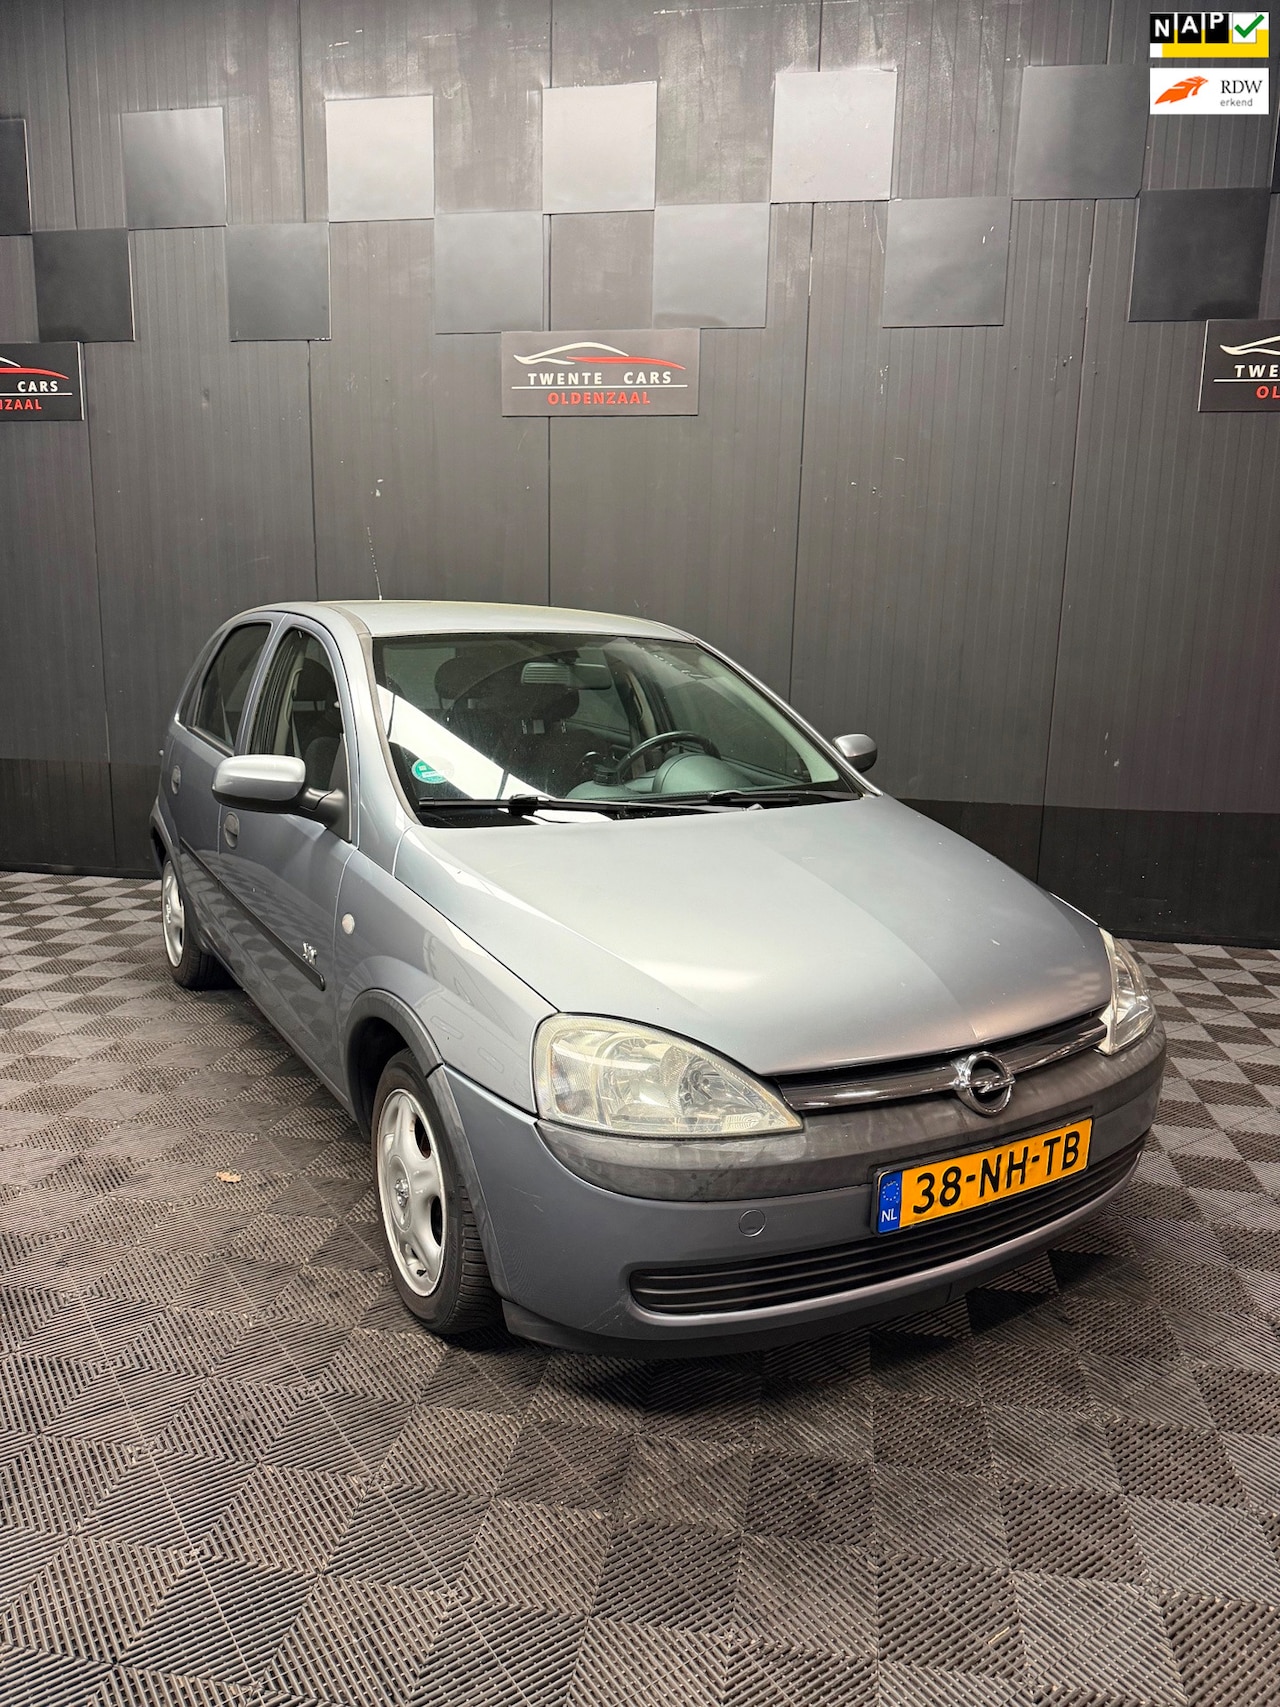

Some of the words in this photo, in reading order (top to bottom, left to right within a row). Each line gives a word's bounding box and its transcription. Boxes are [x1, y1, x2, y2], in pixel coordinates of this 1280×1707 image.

[528, 372, 603, 385] TWENTE
[623, 371, 672, 384] CARS
[17, 380, 59, 392] CARS
[547, 391, 651, 406] OLDENZAAL
[913, 1130, 1081, 1214] 38-NH-TB
[880, 1207, 897, 1222] NL
